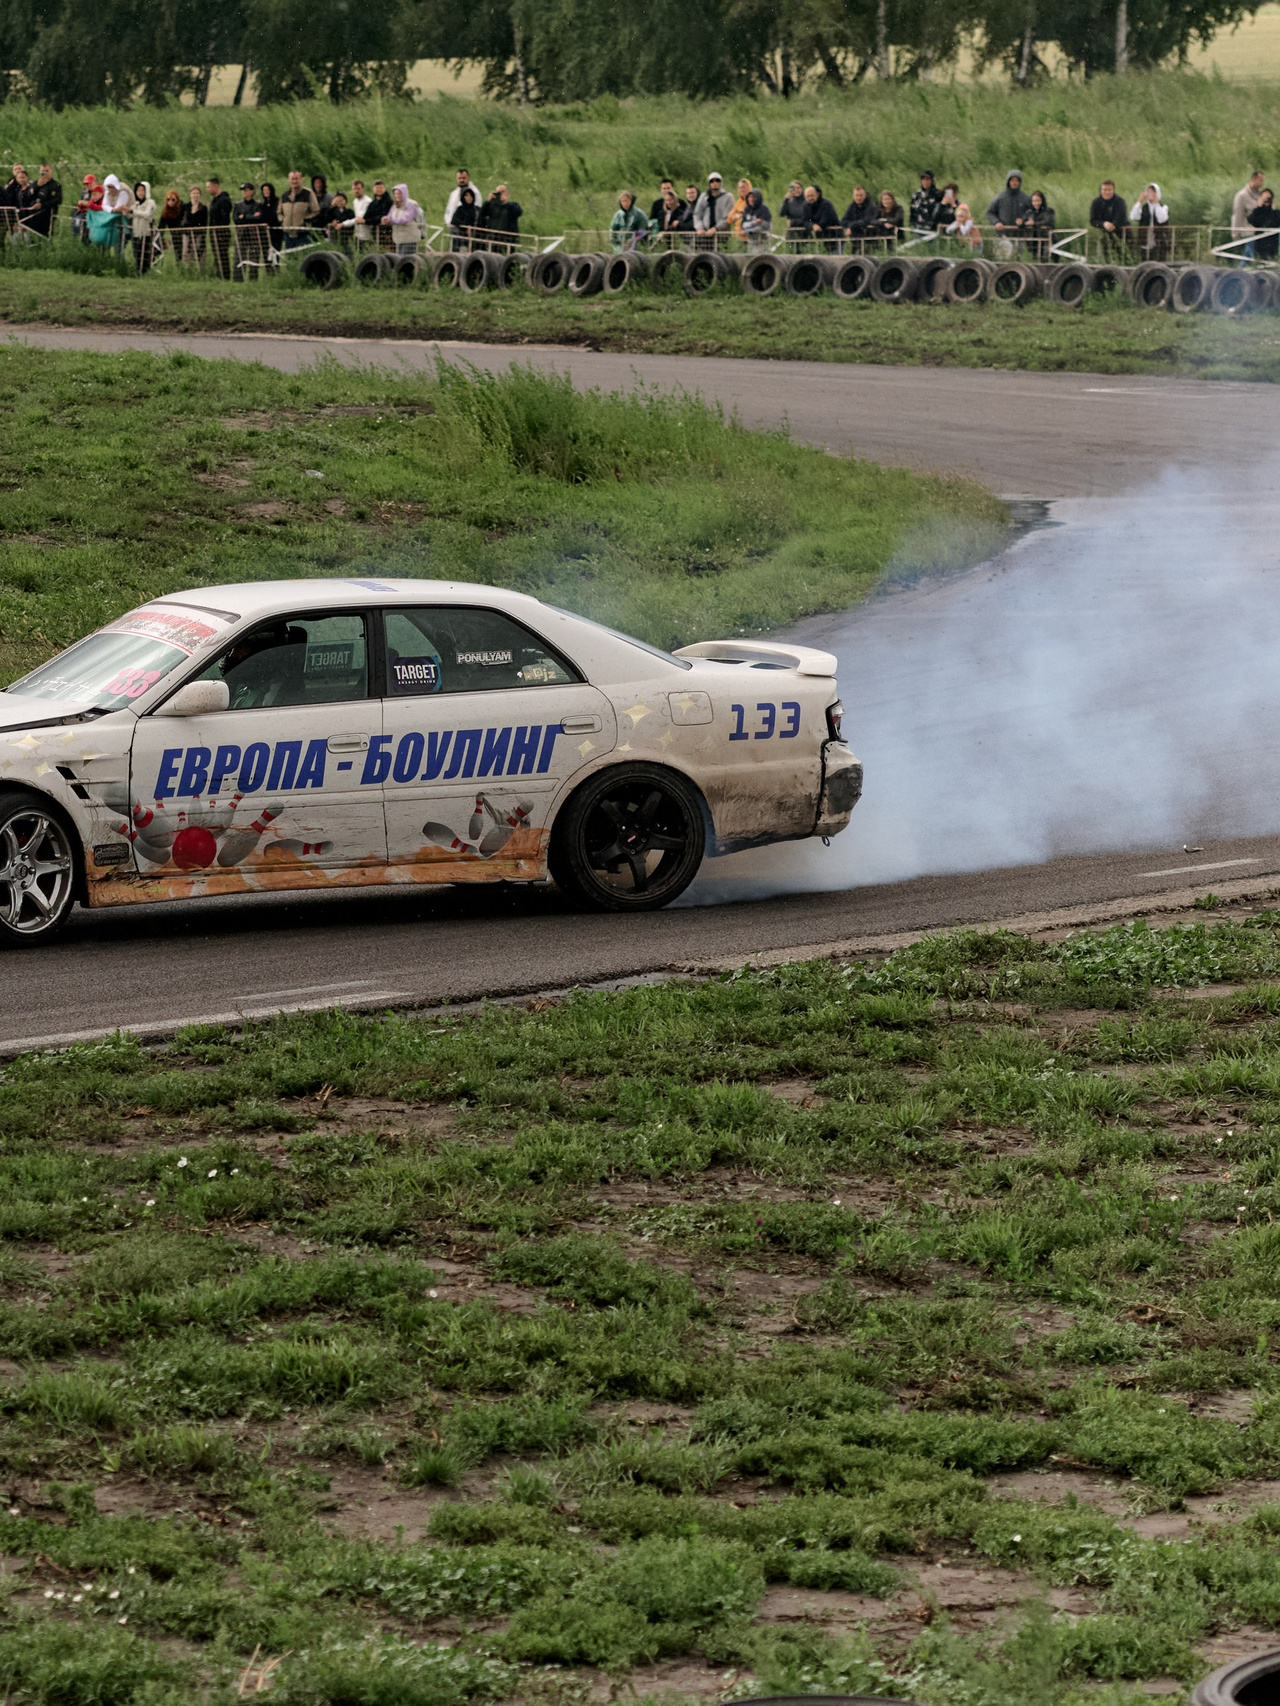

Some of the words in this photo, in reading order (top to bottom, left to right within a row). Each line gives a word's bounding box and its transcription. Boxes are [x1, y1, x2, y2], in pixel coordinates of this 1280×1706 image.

[100, 667, 162, 698] 133
[393, 664, 437, 680] TARGET
[729, 701, 801, 741] 133
[154, 739, 327, 799] ЕВРОПА
[360, 724, 566, 785] БОУЛИНГ
